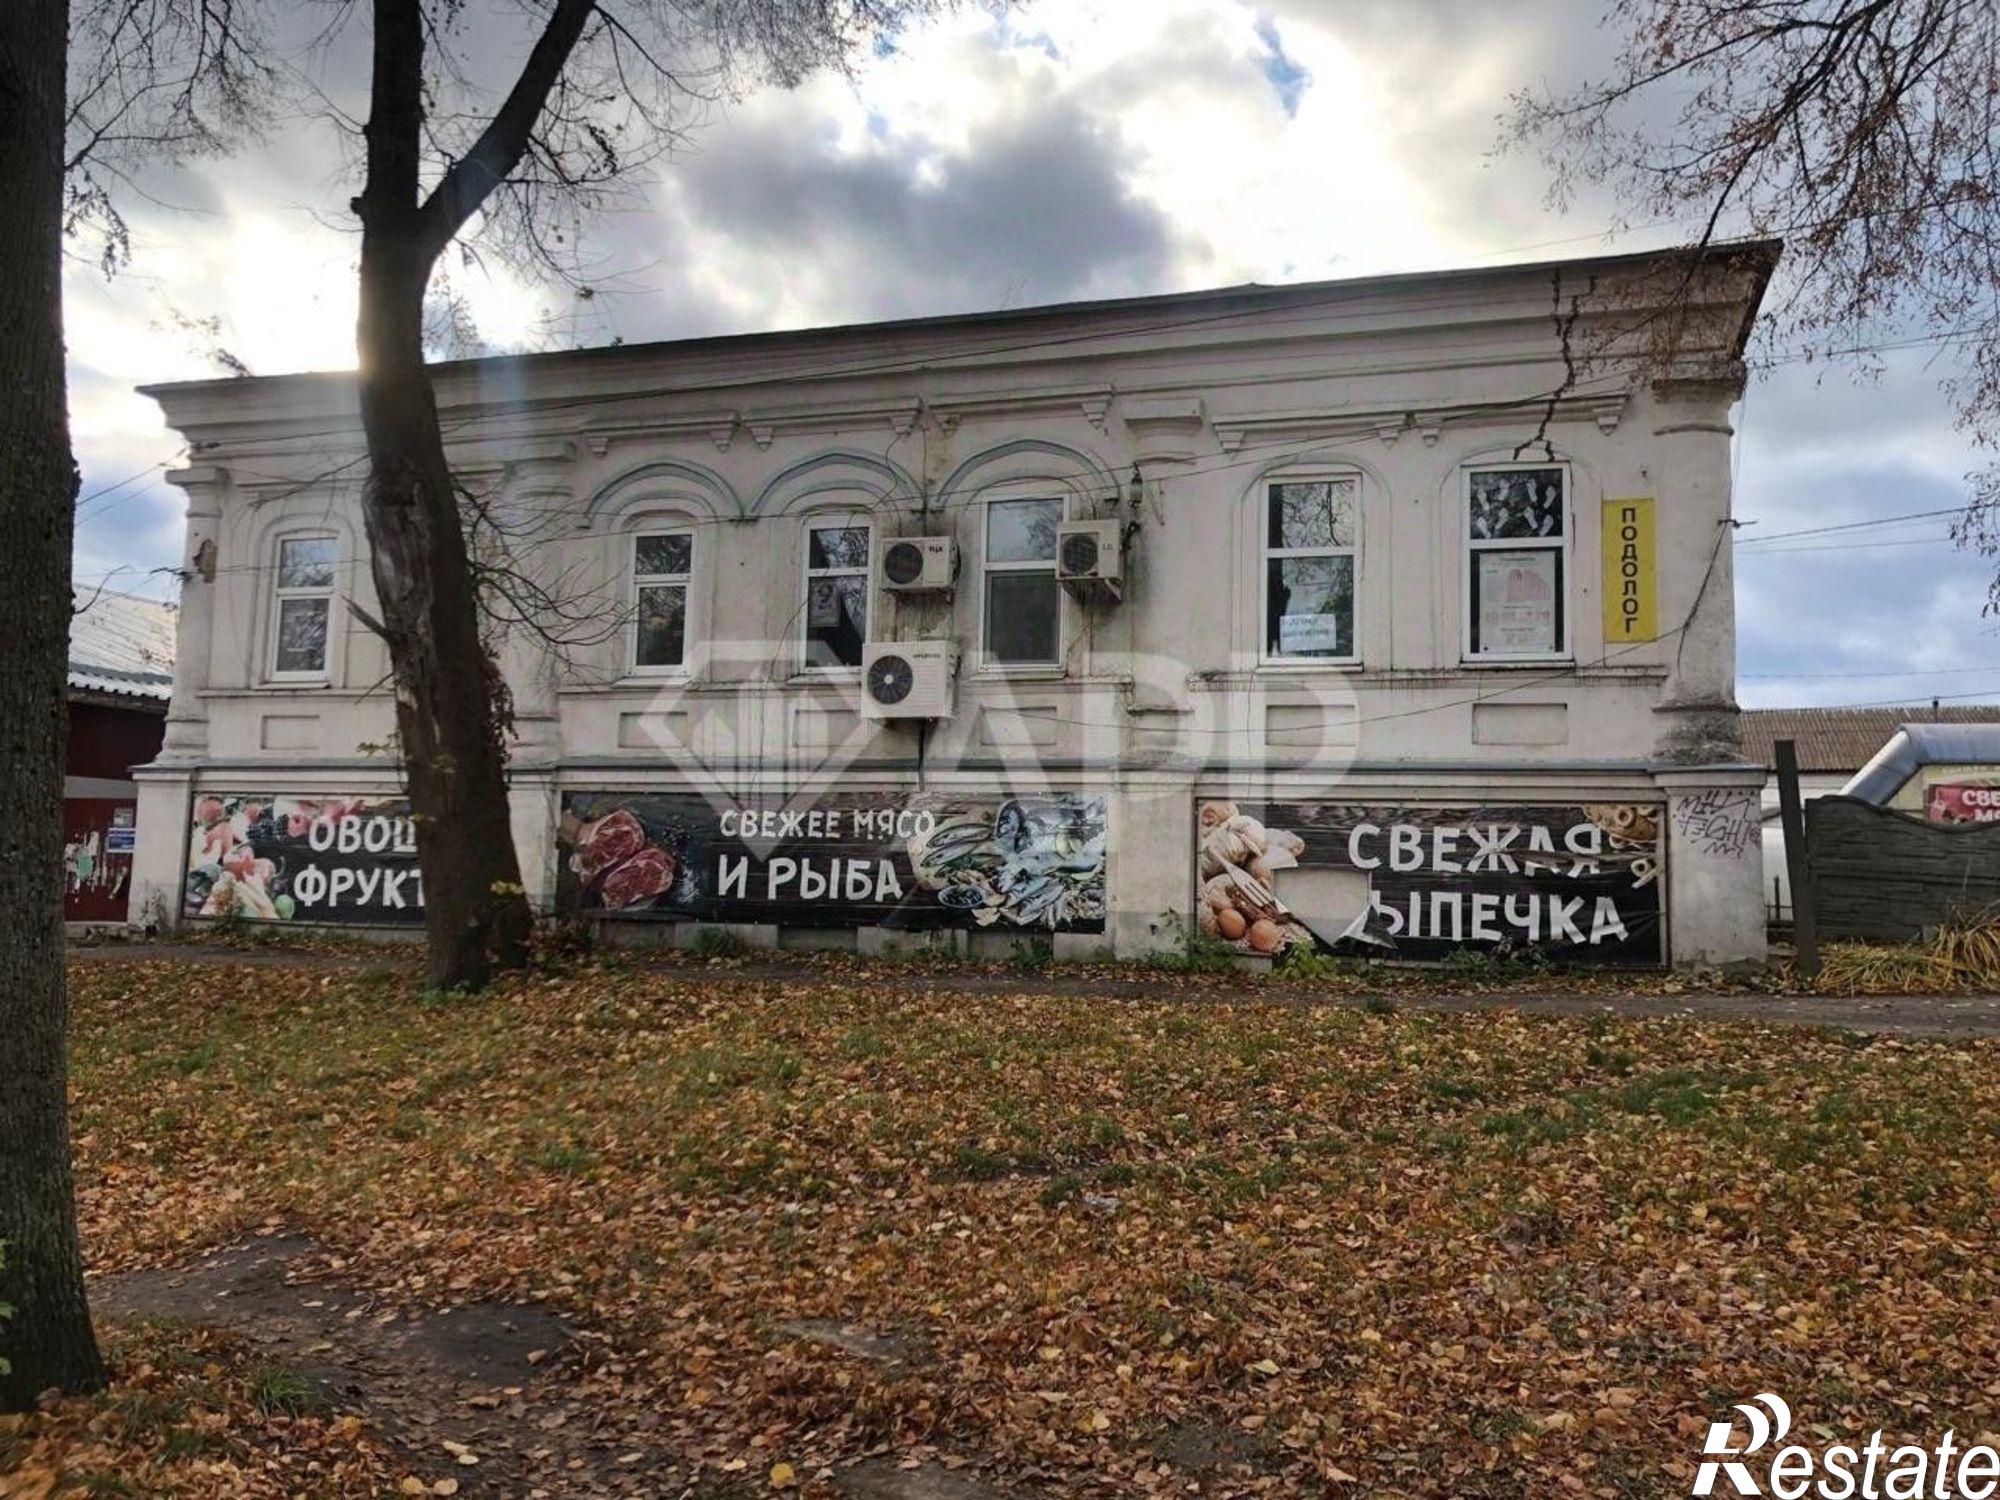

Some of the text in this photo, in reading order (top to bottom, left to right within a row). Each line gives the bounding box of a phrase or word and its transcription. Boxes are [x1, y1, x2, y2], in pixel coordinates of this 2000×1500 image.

[1621, 507, 1638, 634] ПОДОЛОГ
[720, 808, 935, 840] СВЕЖЕЕ МЯСО
[1348, 823, 1601, 878] СВЕЖАЯ
[718, 854, 904, 901] И РЫБА
